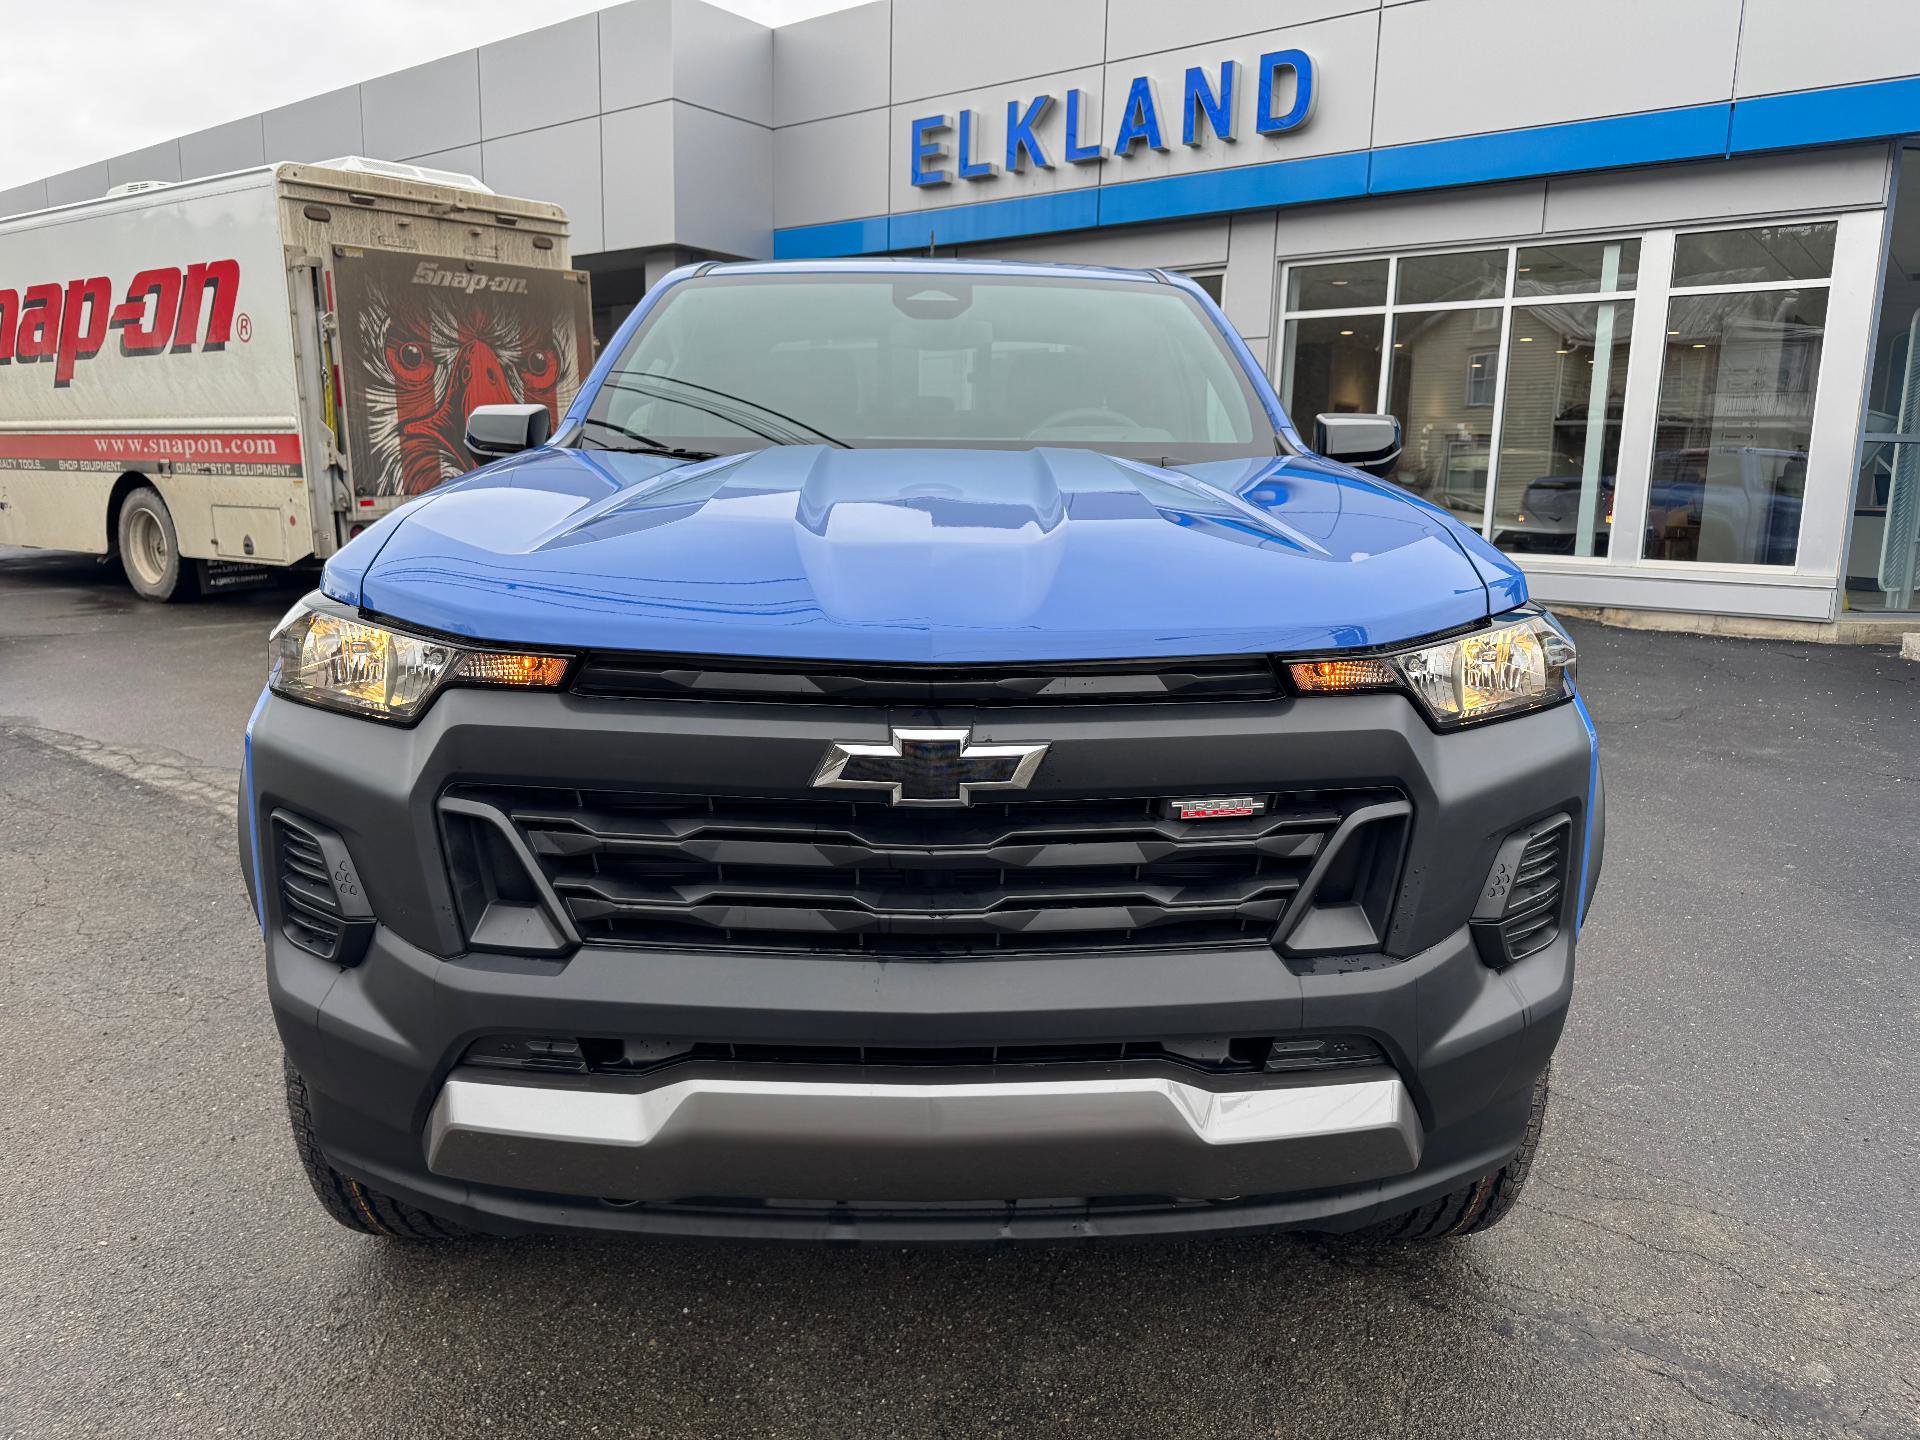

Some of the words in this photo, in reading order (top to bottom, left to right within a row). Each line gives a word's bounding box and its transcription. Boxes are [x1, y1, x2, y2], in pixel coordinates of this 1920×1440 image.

[911, 48, 1318, 188] ELKLAND
[411, 261, 527, 294] Snap-on
[95, 438, 277, 458] www.snapon.com
[58, 460, 78, 470] SHOP
[1171, 798, 1264, 811] TRAIL
